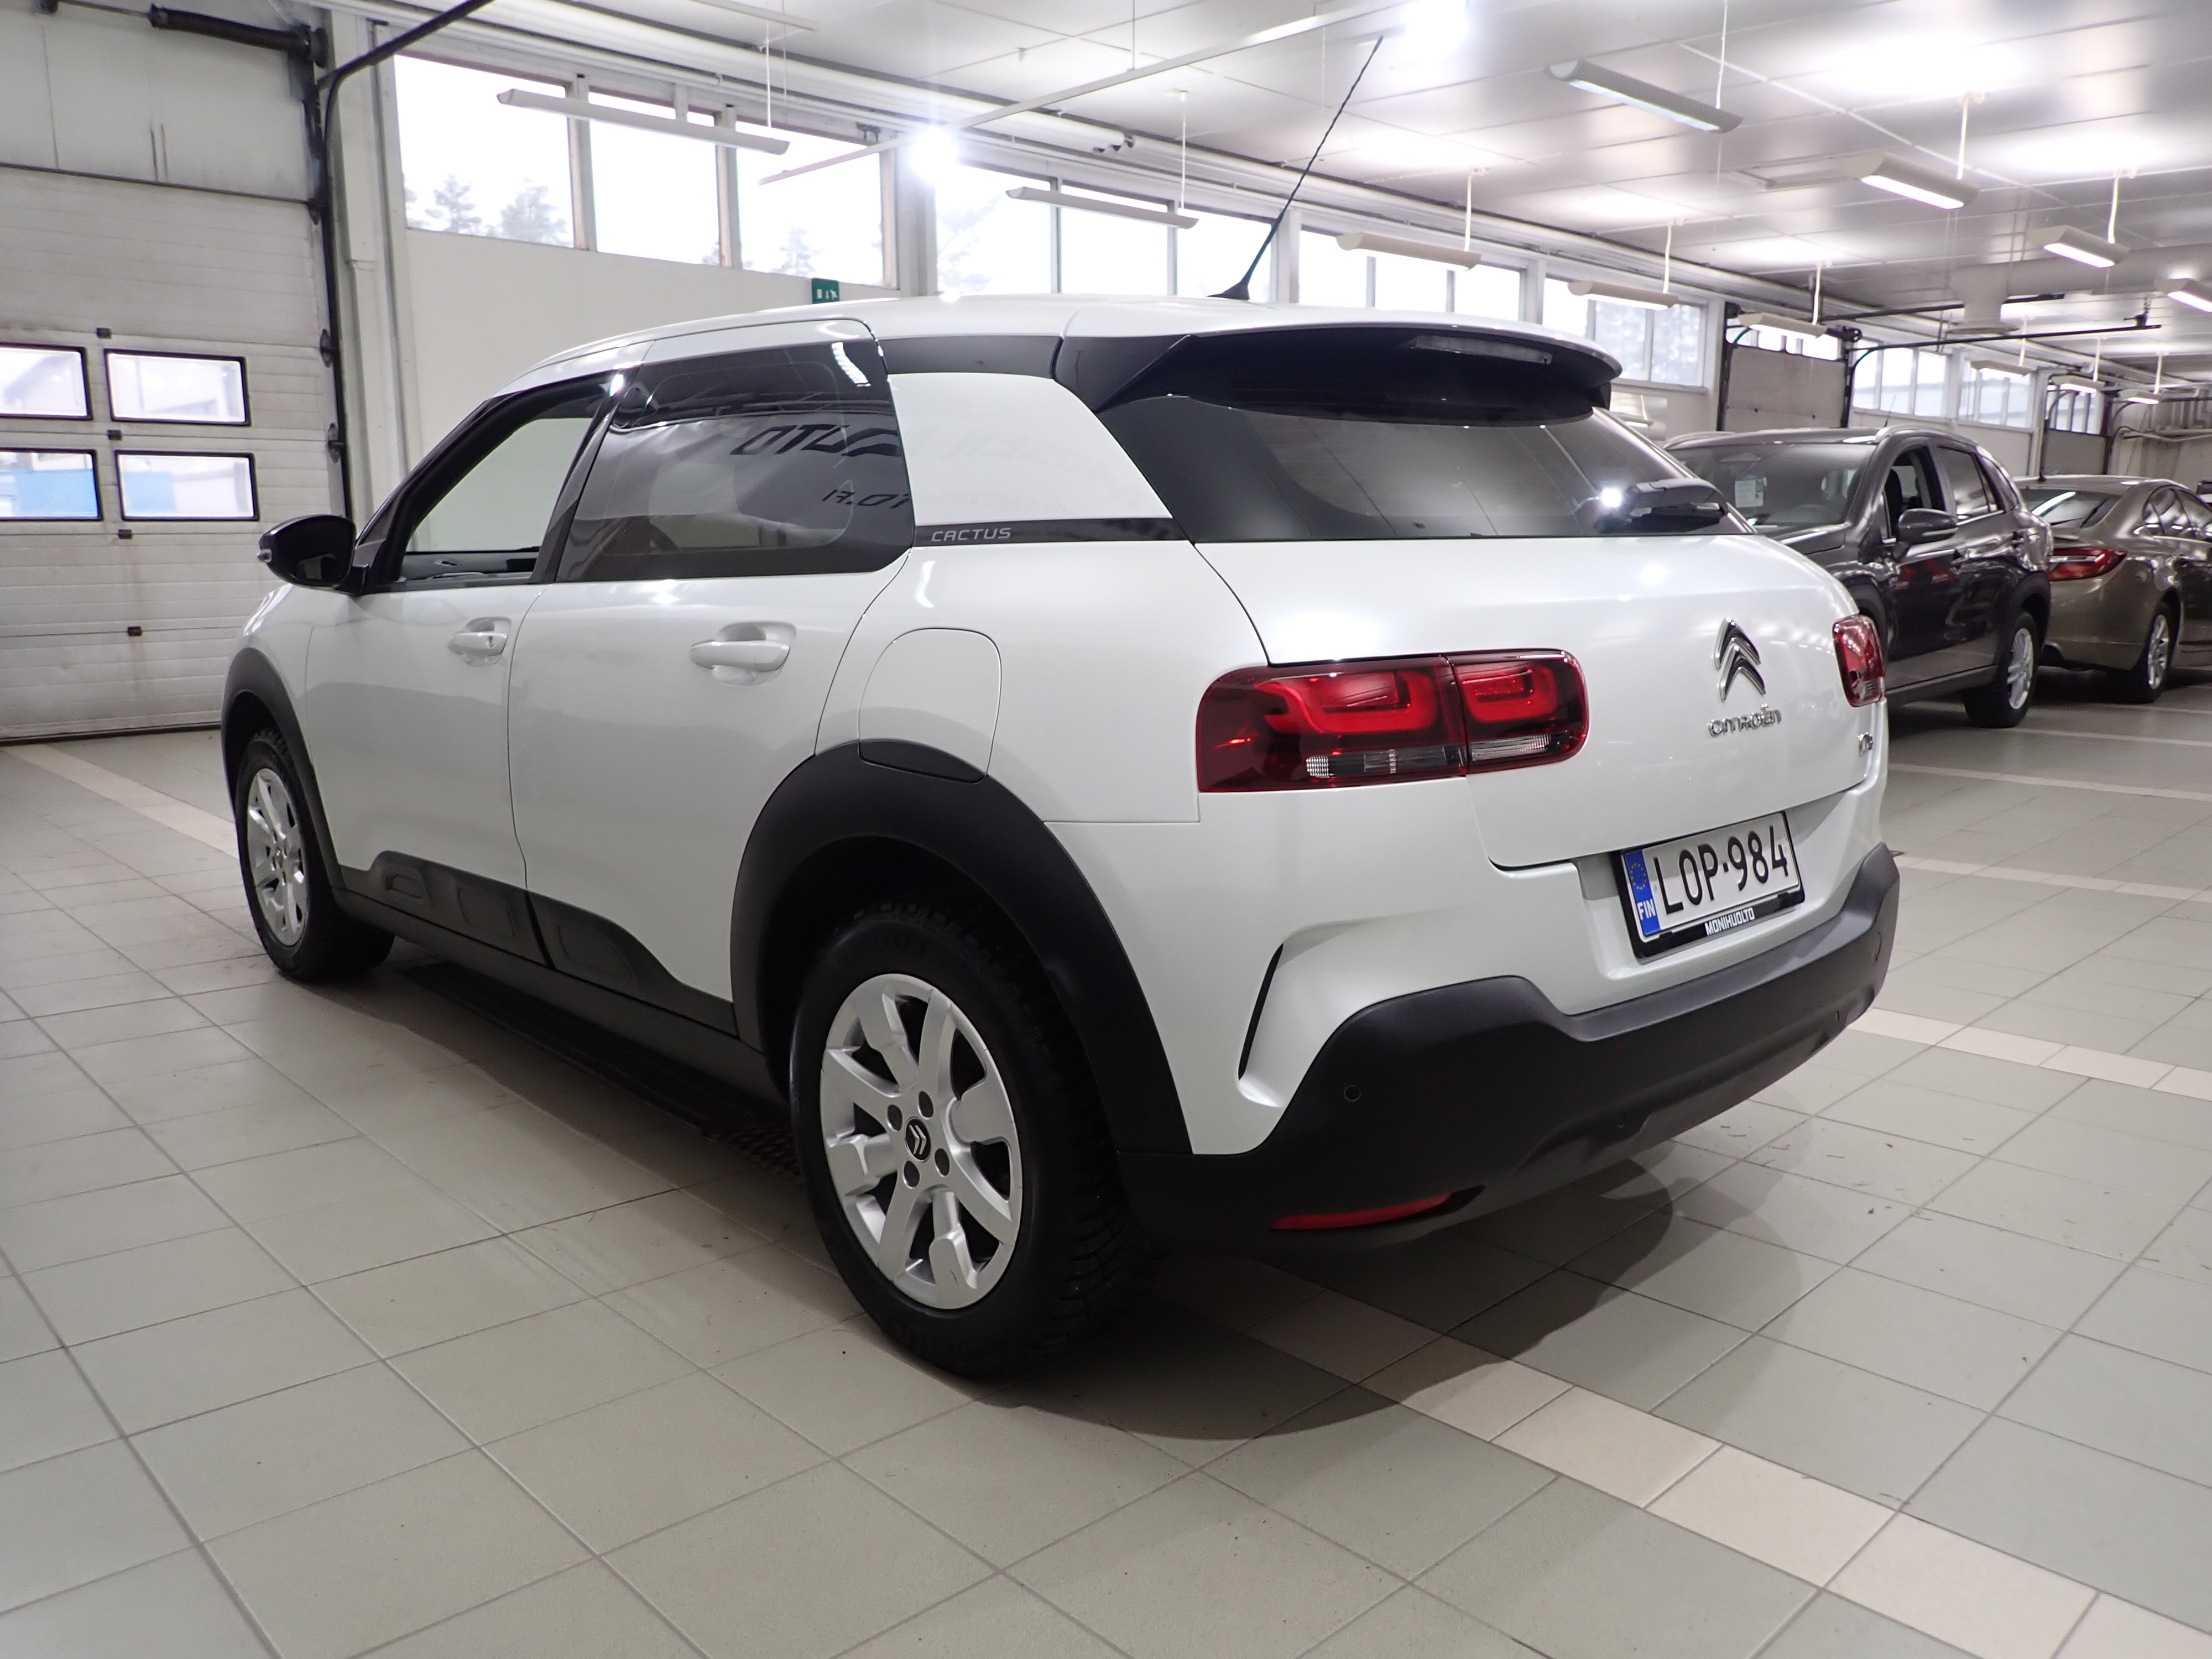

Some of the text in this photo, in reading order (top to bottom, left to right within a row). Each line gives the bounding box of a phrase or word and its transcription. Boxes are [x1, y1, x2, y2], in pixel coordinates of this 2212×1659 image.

[931, 527, 1011, 542] CACTUS
[1653, 825, 1789, 915] LOP-984
[1637, 899, 1657, 920] FIN
[1704, 907, 1755, 936] MONIHUOLTO
